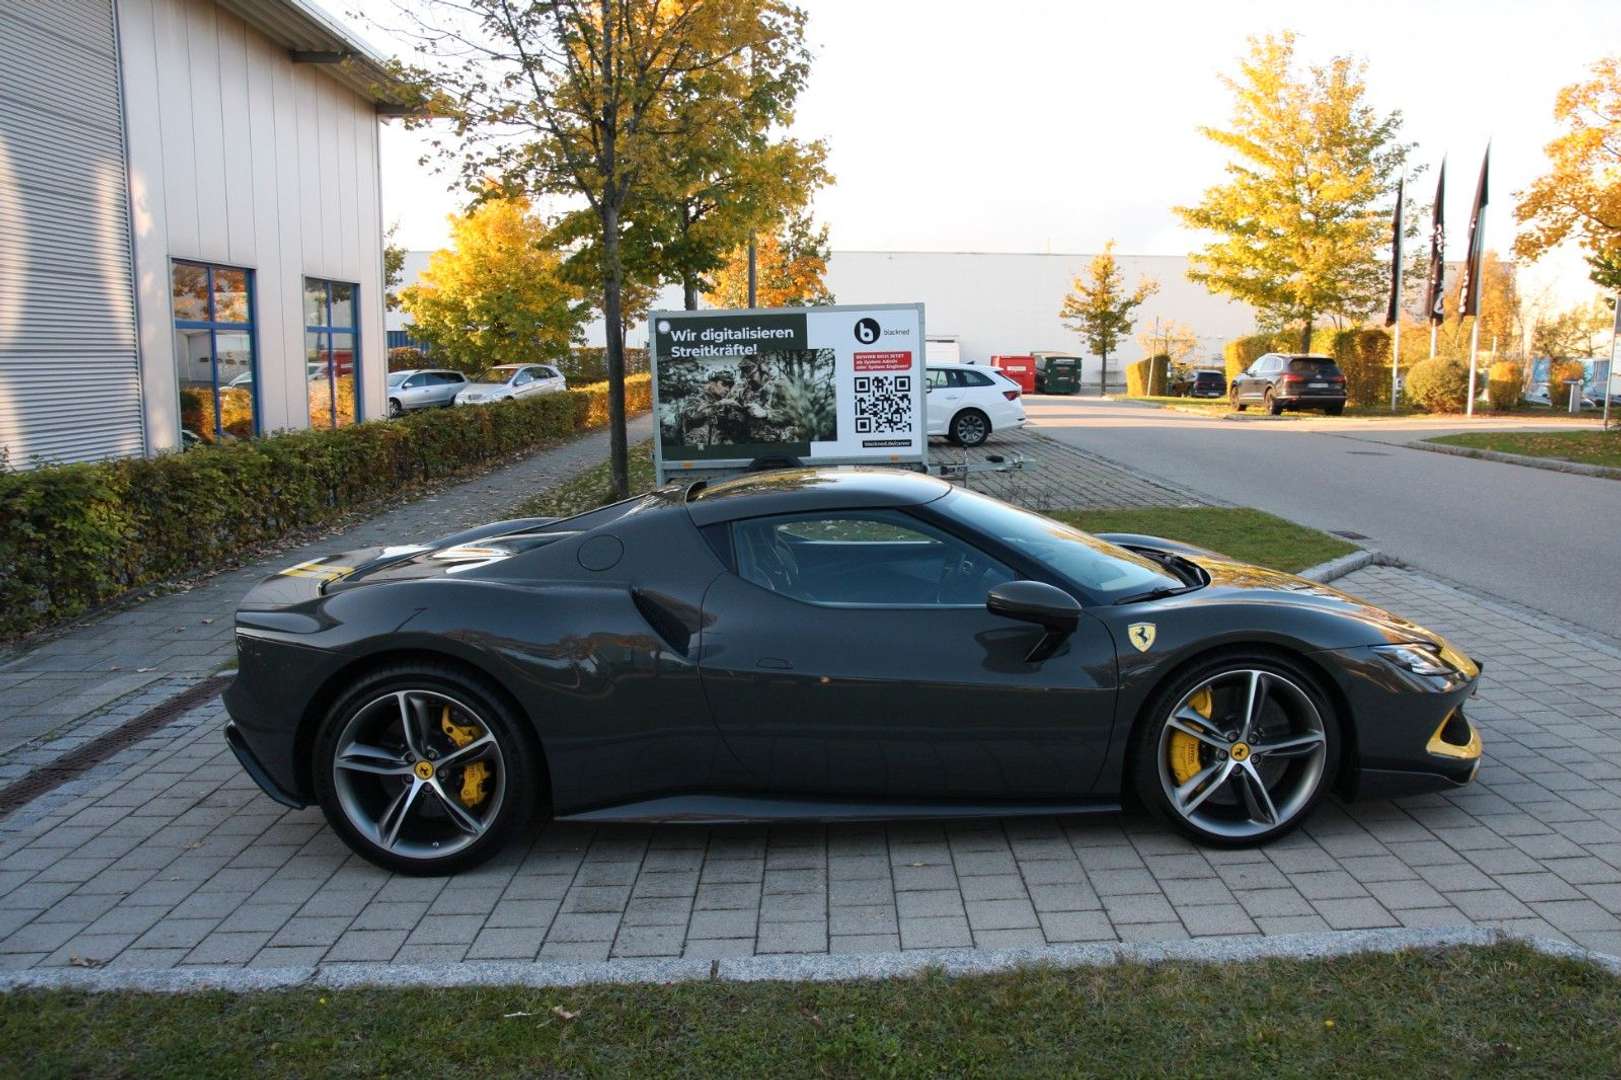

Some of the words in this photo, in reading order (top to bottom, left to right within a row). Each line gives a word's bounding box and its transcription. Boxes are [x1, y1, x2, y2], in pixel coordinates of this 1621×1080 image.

[671, 328, 697, 342] Wir
[700, 326, 794, 343] digitalisieren
[671, 343, 758, 358] Streitkräfte!
